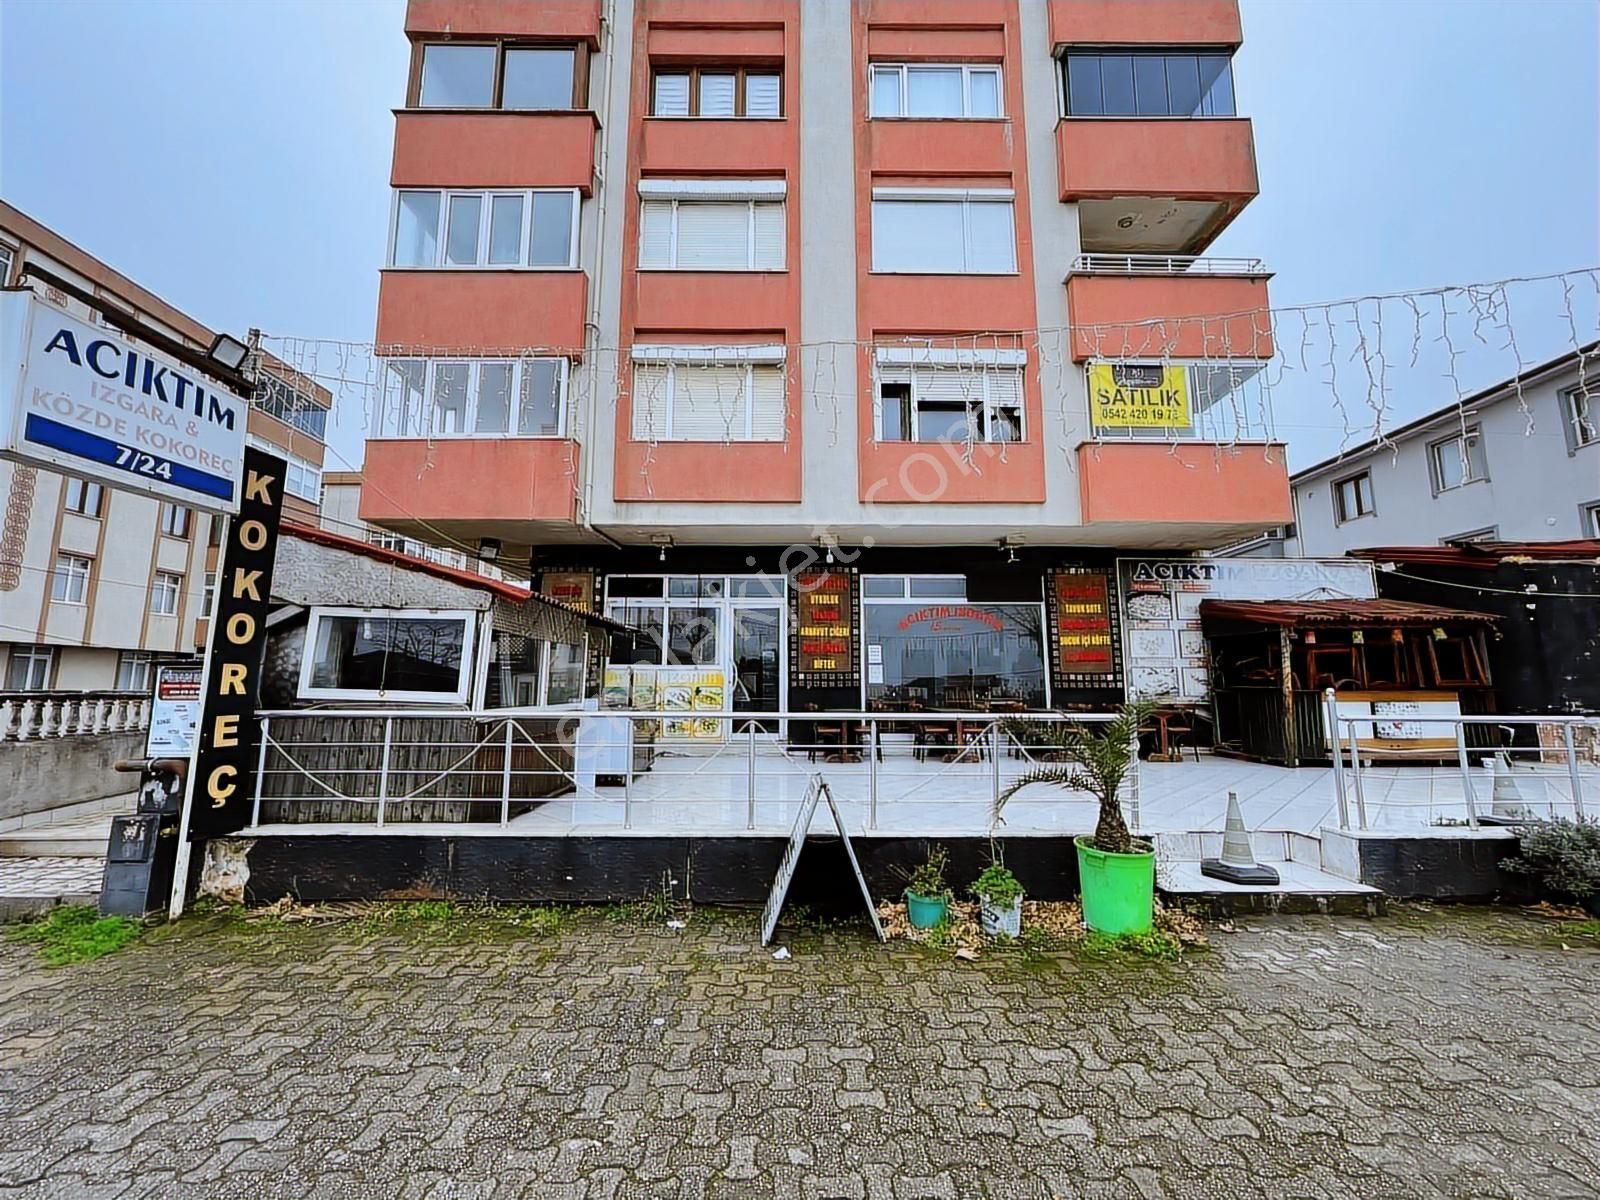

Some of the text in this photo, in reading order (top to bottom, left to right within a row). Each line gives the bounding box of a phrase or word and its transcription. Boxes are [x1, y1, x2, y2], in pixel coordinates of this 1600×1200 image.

[44, 329, 235, 431] ACIKTIM
[1097, 388, 1181, 407] SATILIK
[32, 386, 127, 437] KÖZDE
[90, 380, 199, 438] IZGARA &
[1102, 408, 1127, 419] 0542
[1129, 409, 1148, 419] 420
[1152, 409, 1164, 420] 19
[207, 470, 275, 808] KOKOREÇ
